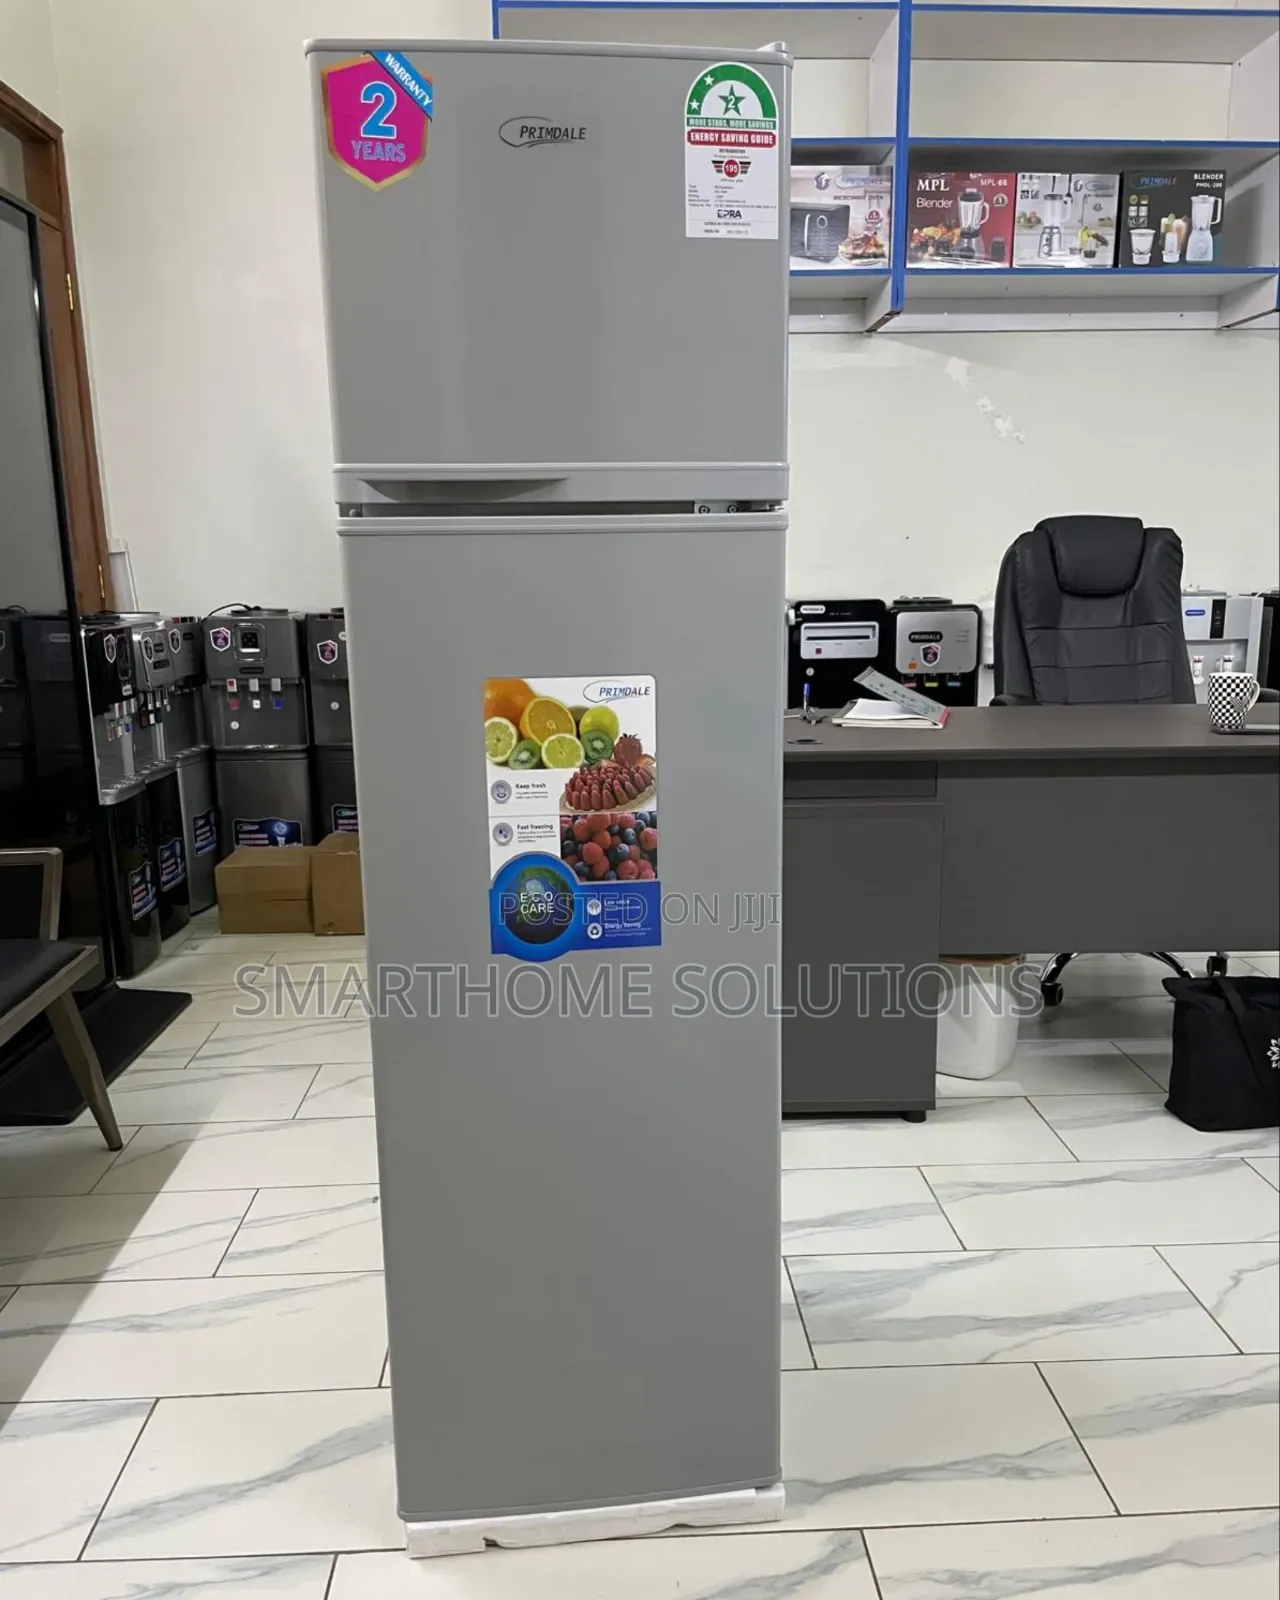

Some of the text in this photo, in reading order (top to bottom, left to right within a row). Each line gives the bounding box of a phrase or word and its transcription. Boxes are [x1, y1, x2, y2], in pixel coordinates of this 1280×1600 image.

[384, 53, 433, 107] WARRANTY
[727, 95, 736, 109] 2
[360, 80, 397, 139] 2
[729, 120, 747, 128] MORE
[748, 121, 774, 129] SAVINGS
[519, 125, 587, 140] PRIMDALE
[690, 132, 774, 144] ENERGY SAVING GUIDE
[351, 140, 406, 163] YEARS
[1193, 173, 1224, 181] BLENDER
[916, 179, 950, 192] MPL
[916, 197, 953, 209] Blender
[599, 686, 651, 697] PRIMDALE
[520, 902, 555, 915] CARE
